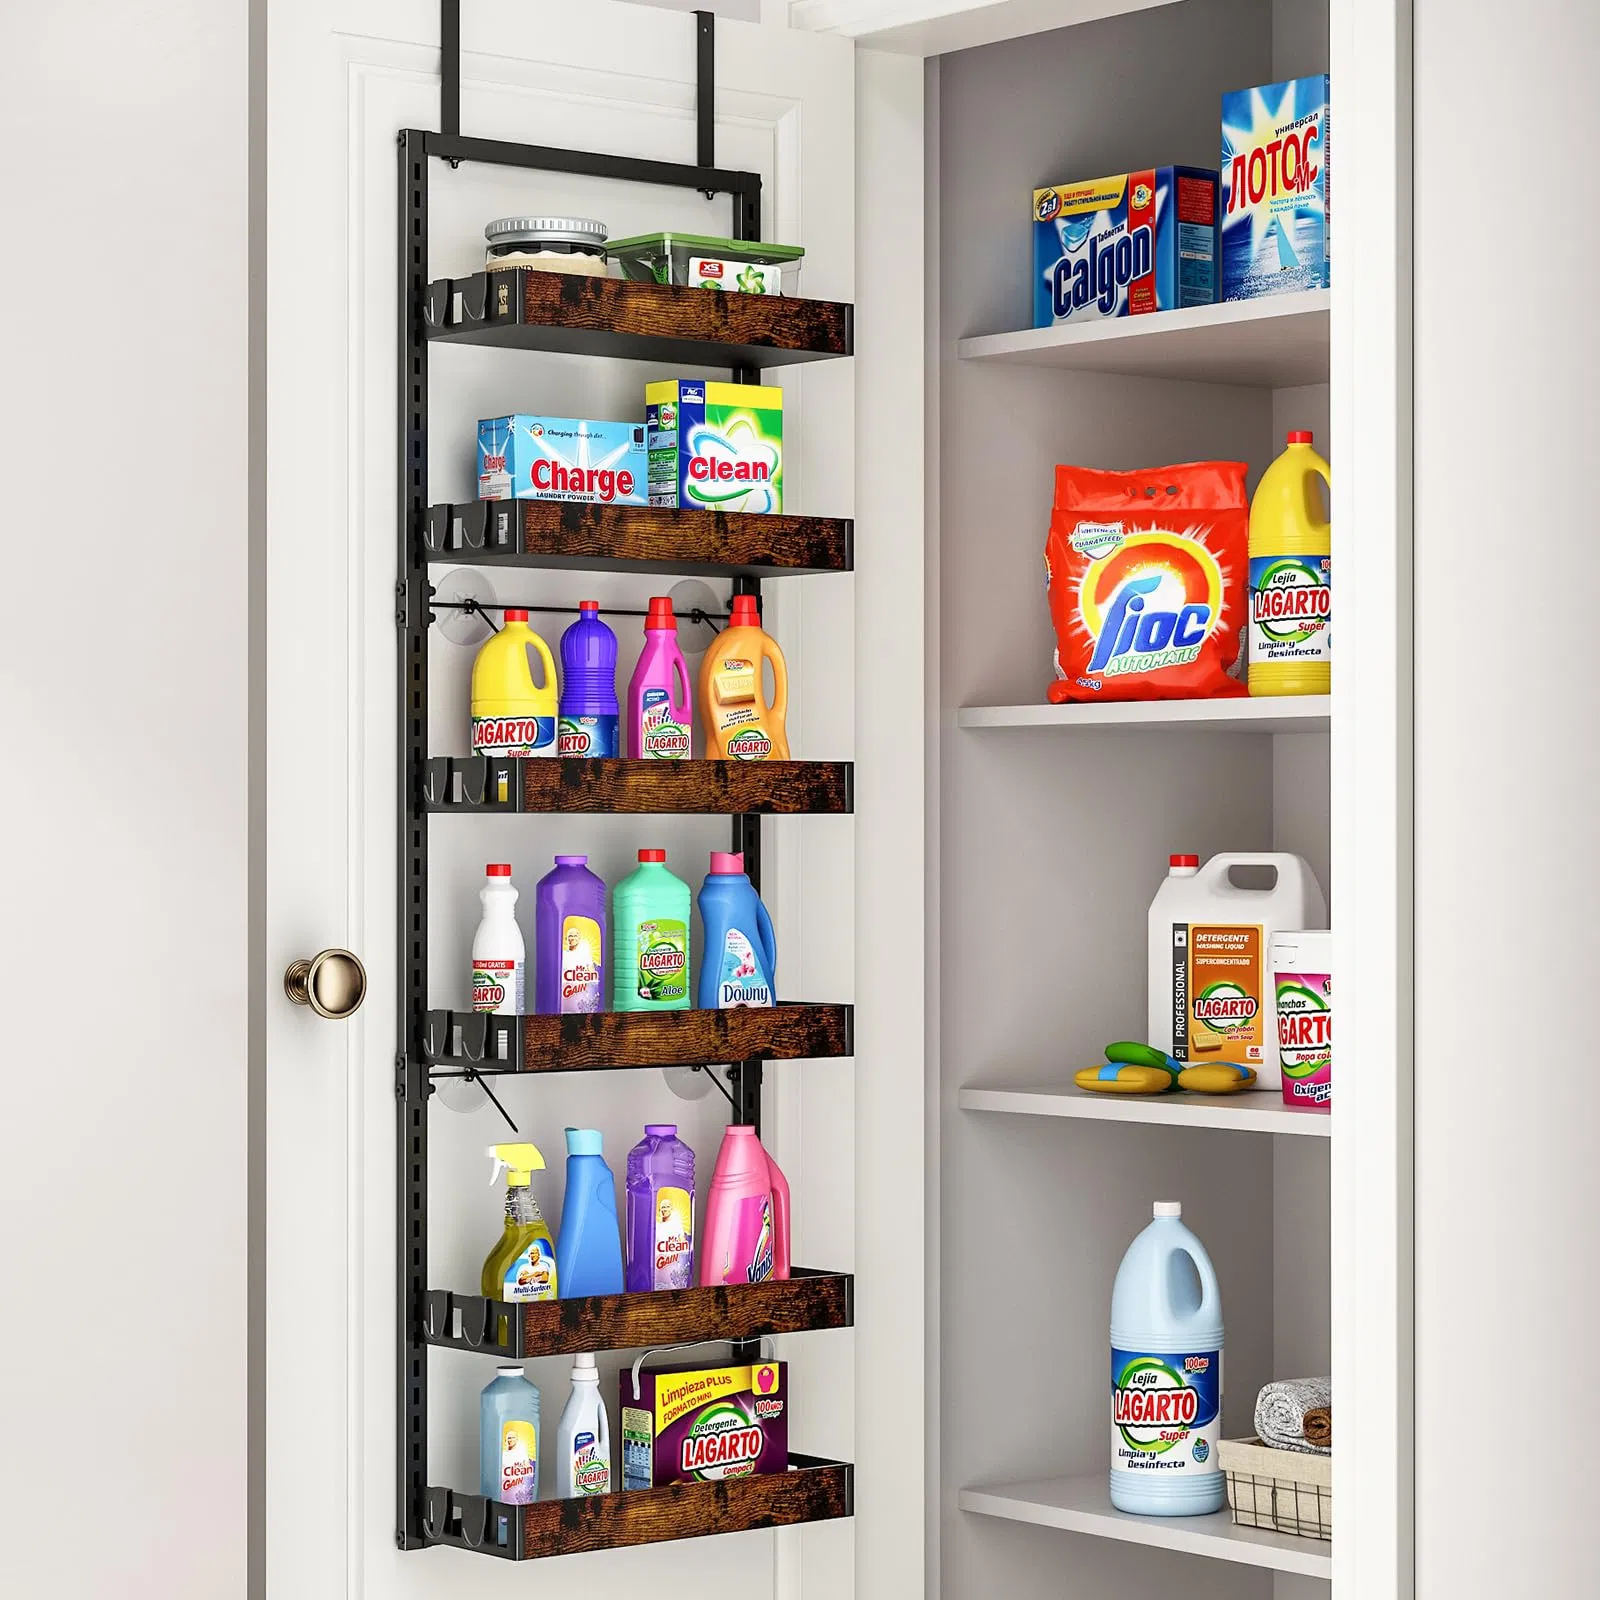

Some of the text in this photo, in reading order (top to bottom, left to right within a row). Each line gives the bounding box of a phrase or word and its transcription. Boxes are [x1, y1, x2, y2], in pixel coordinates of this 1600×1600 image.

[1274, 112, 1319, 138] универсал
[1227, 125, 1318, 215] ЛОТОС
[1098, 223, 1125, 244] Таблетки
[1053, 226, 1152, 318] Calgon
[547, 429, 573, 438] Charging
[689, 456, 769, 480] Clean
[531, 459, 634, 502] Charge
[536, 492, 566, 500] LAUNDRY
[1272, 572, 1297, 585] Lejía
[1255, 589, 1330, 619] LAGARTO
[1298, 622, 1326, 633] Super
[1258, 640, 1286, 651] Limpia
[1105, 646, 1201, 675] AUTOMATIC
[1267, 648, 1322, 659] Desinfecta
[647, 736, 688, 750] LAGARTO
[730, 741, 770, 754] LAGARTO
[506, 749, 532, 758] Super
[1196, 933, 1250, 943] DETERGENTE
[642, 953, 683, 969] LAGARTO
[563, 969, 598, 982] Clean
[562, 983, 588, 998] GAIN
[661, 985, 683, 996] Aloe
[723, 984, 768, 1005] Downy
[1175, 960, 1186, 1038] PROFESSIONAL
[1196, 999, 1255, 1018] LAGARTO
[1175, 1049, 1186, 1059] 5L
[1295, 1052, 1316, 1063] Ropa
[657, 1240, 689, 1253] Clean
[656, 1253, 679, 1270] GAIN
[1132, 1372, 1158, 1387] Lejía
[661, 1375, 733, 1408] Limpieza PLUS
[663, 1391, 713, 1424] FORMATO MINI
[1114, 1391, 1196, 1422] LAGARTO
[694, 1418, 738, 1434] Detergente
[1159, 1430, 1190, 1442] Super
[684, 1429, 761, 1468] LAGARTO
[1118, 1448, 1157, 1460] Limpia y
[503, 1466, 534, 1477] Clean
[722, 1462, 754, 1476] Compact
[1127, 1460, 1186, 1470] Desinfecta
[502, 1477, 524, 1491] GAIN
[576, 1468, 609, 1486] LAGARTO
